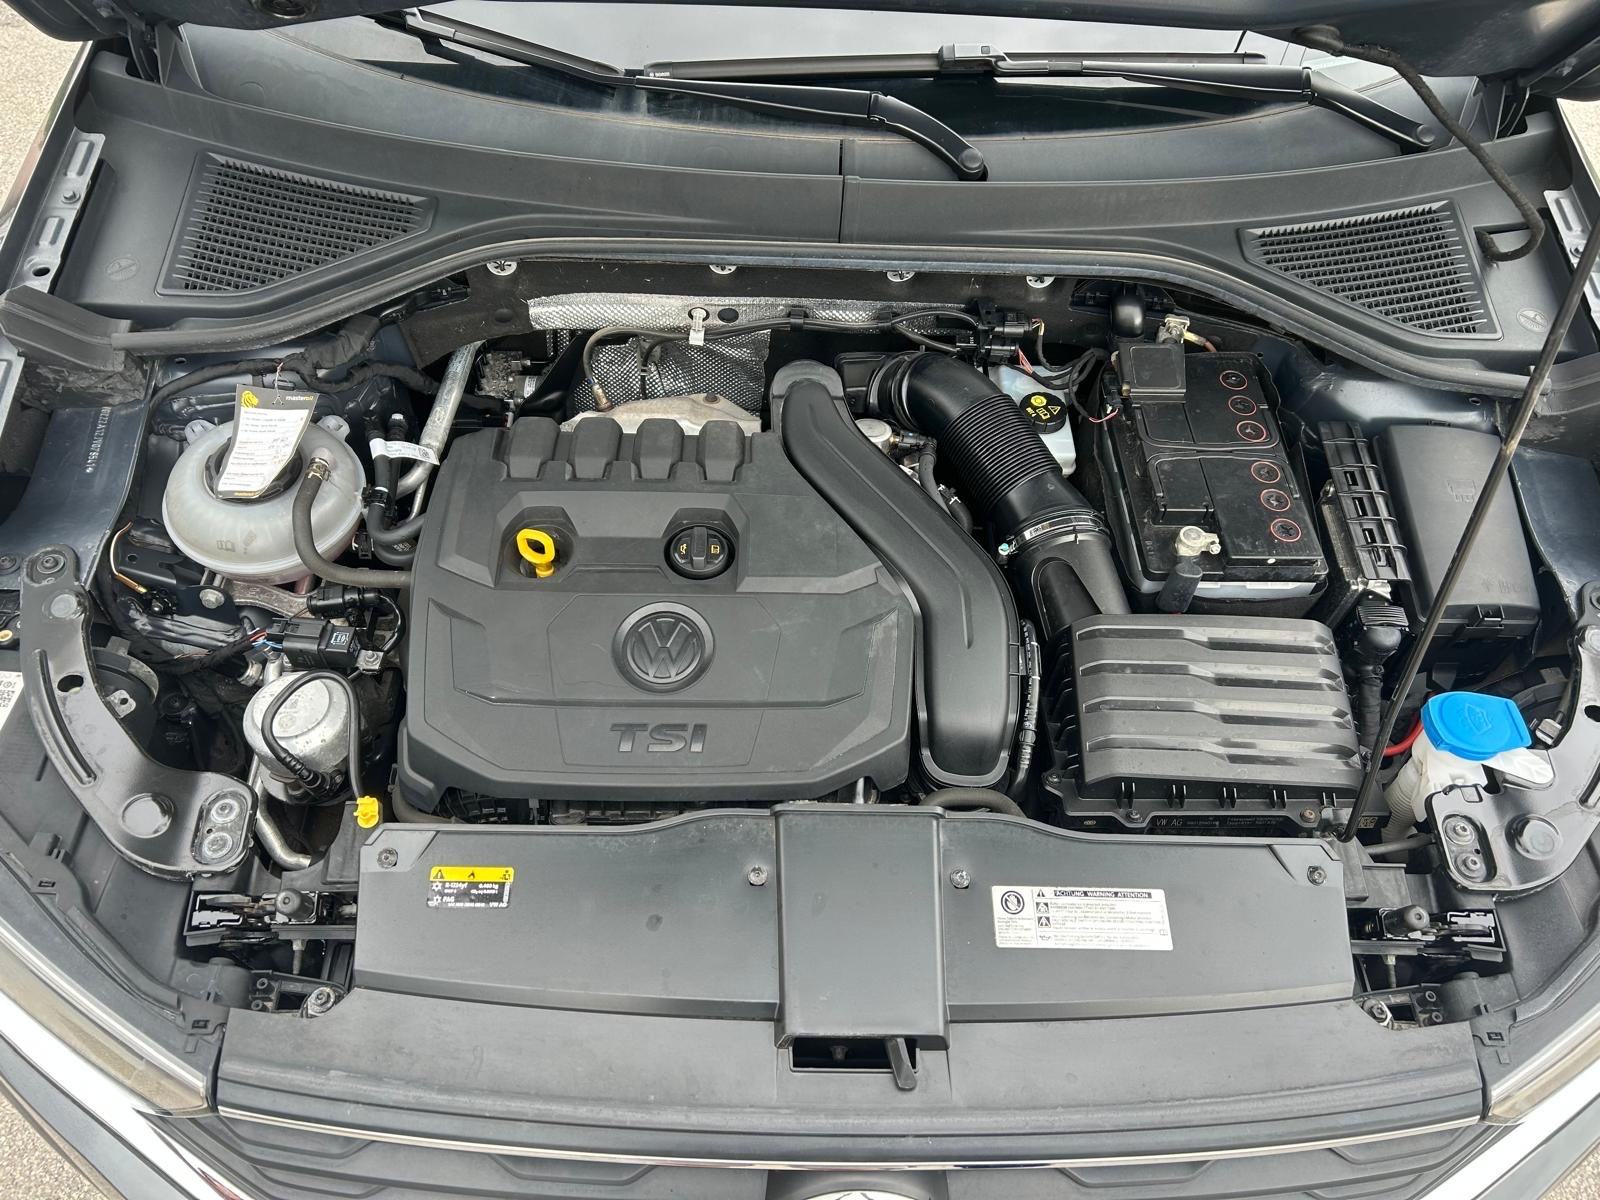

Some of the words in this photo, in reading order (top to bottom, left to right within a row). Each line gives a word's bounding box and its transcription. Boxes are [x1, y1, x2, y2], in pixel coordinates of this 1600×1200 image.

[609, 723, 707, 754] TSI
[1156, 818, 1167, 827] VW
[1171, 818, 1184, 827] AG
[1117, 891, 1149, 899] ATTENTION
